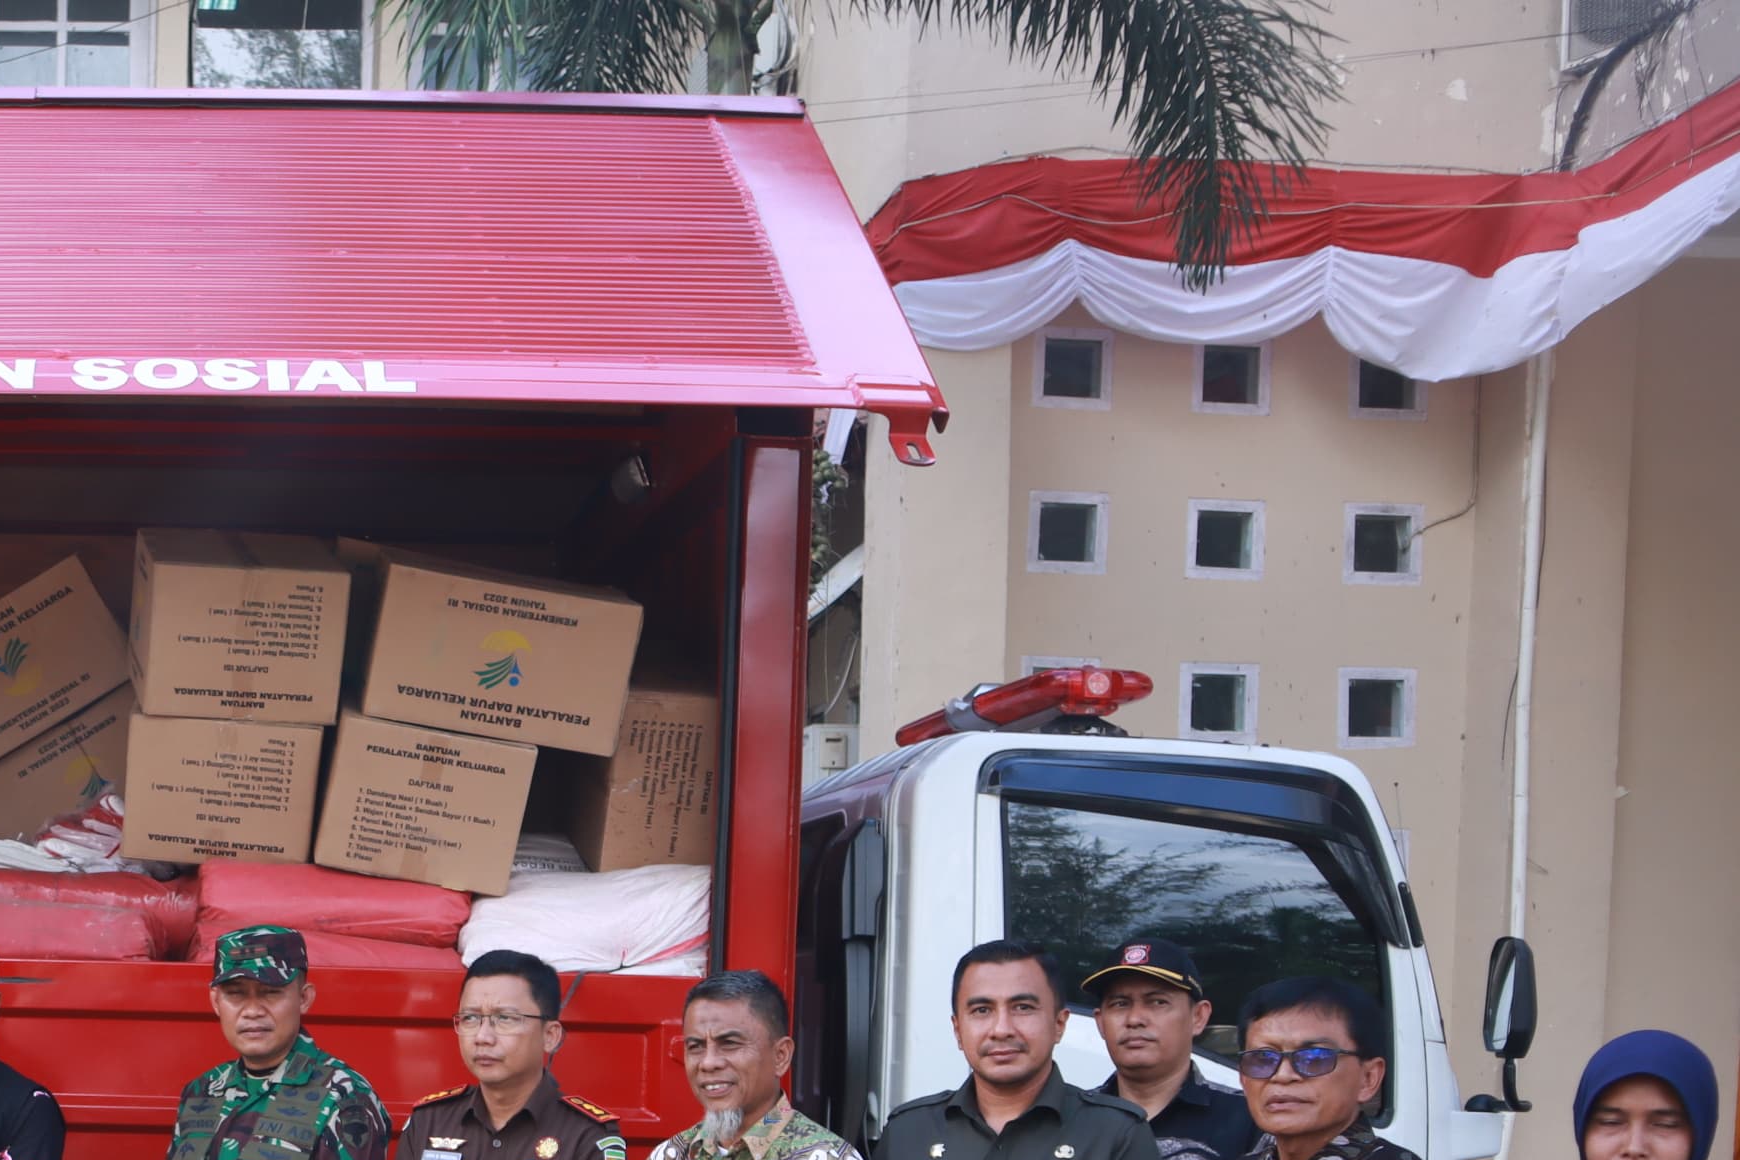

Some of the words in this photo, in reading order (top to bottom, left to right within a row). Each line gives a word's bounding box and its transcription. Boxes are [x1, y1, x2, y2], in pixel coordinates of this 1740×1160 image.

[72, 357, 419, 393] SOSIAL
[17, 586, 73, 623] KELUARGA
[447, 598, 459, 607] RI
[483, 593, 508, 604] 2023
[510, 597, 546, 610] TAHUN
[462, 600, 499, 614] SOSIAL
[502, 608, 578, 627] KEMENTERIAN
[235, 665, 269, 673] DAFTAR
[49, 681, 80, 701] SOSIAL
[174, 688, 224, 696] KELUARGA
[226, 690, 257, 699] DAPUR
[259, 692, 313, 702] PERALATAN
[397, 684, 466, 705] KELUARGA
[221, 700, 265, 708] BANTUAN
[469, 697, 513, 713] DAPUR
[19, 710, 49, 730] TAHUN
[49, 697, 70, 712] 2023
[460, 709, 522, 728] BANTUAN
[516, 705, 590, 726] PERALATAN
[416, 743, 460, 757] BANTUAN
[366, 744, 420, 760] PERALATAN
[423, 754, 454, 766] DAPUR
[456, 760, 505, 775] KELUARGA
[408, 779, 441, 790] DAFTAR
[208, 814, 241, 824] DAFTAR
[148, 833, 196, 845] KELUARGA
[199, 839, 229, 848] DAPUR
[193, 847, 237, 857] BANTUAN
[231, 842, 284, 853] PERALATAN
